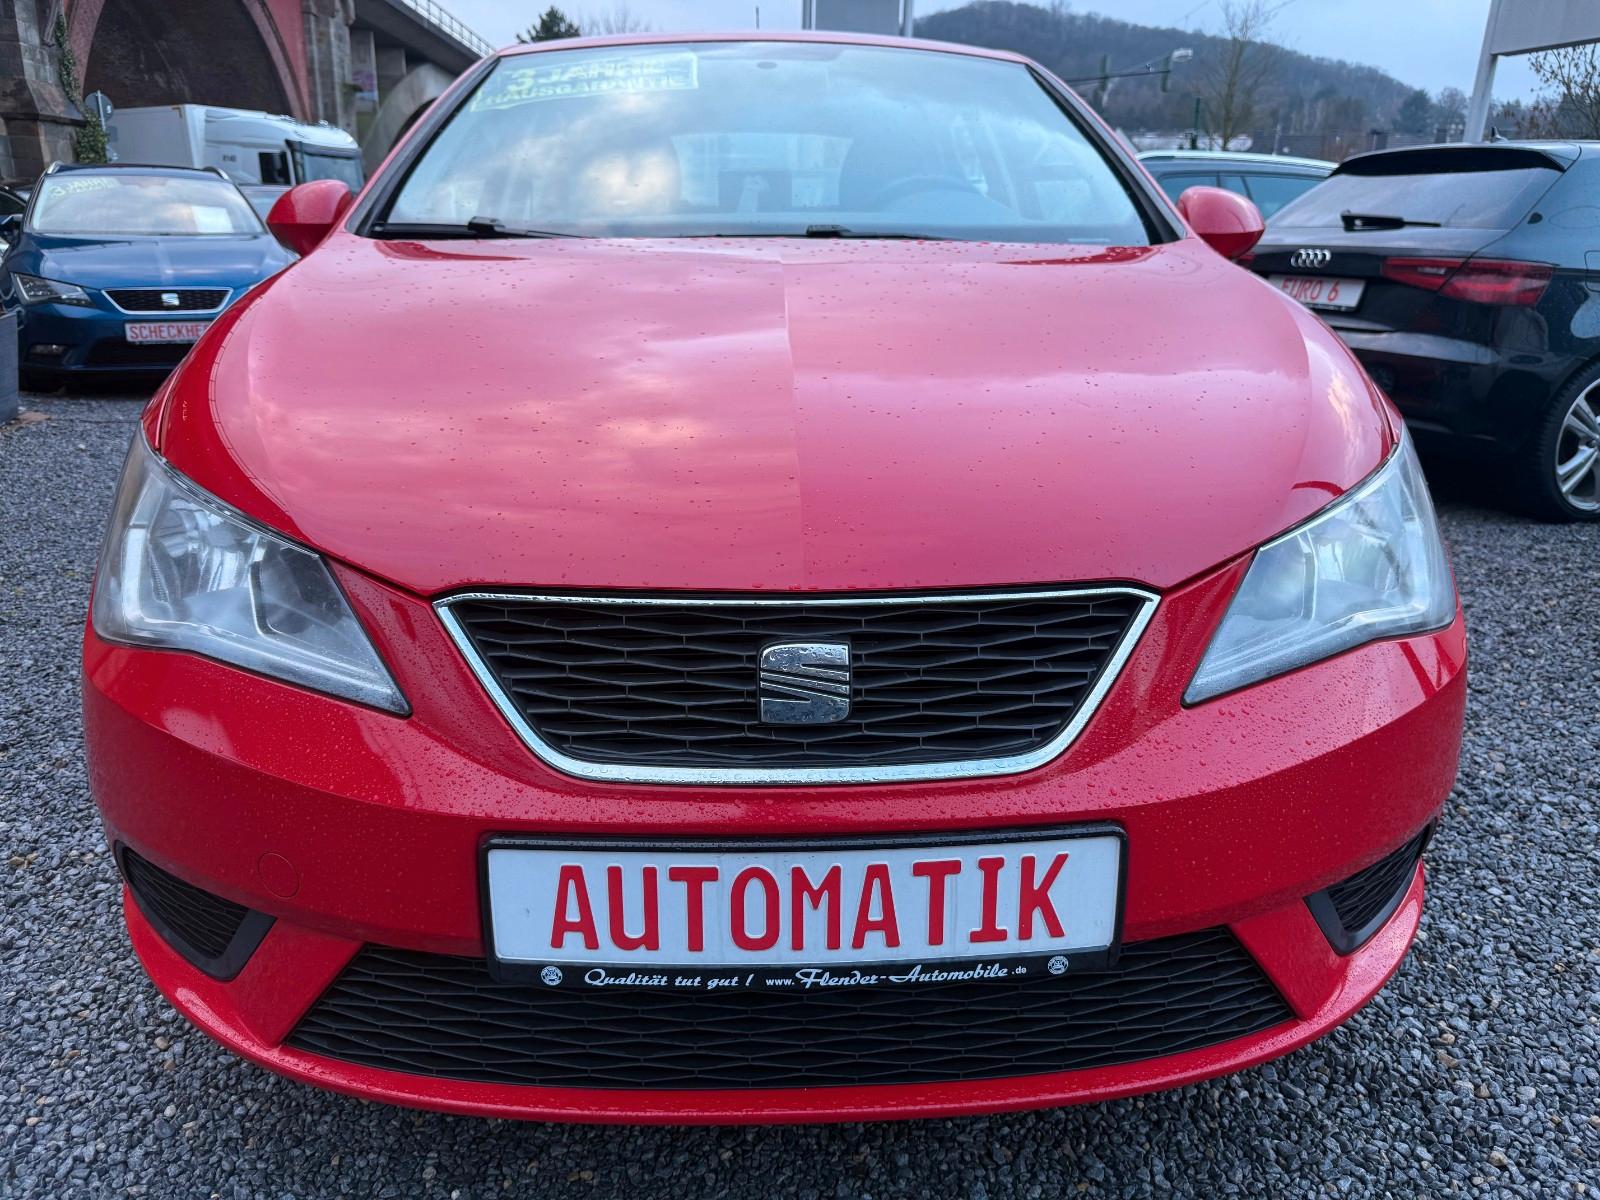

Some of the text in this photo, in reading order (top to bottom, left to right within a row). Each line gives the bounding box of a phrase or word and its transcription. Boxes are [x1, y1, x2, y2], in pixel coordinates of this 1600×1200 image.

[1281, 277, 1340, 301] EURO 6
[551, 853, 1068, 951] AUTOMATIK
[584, 968, 668, 986] Qualität
[674, 975, 702, 987] tut
[707, 976, 739, 990] gut
